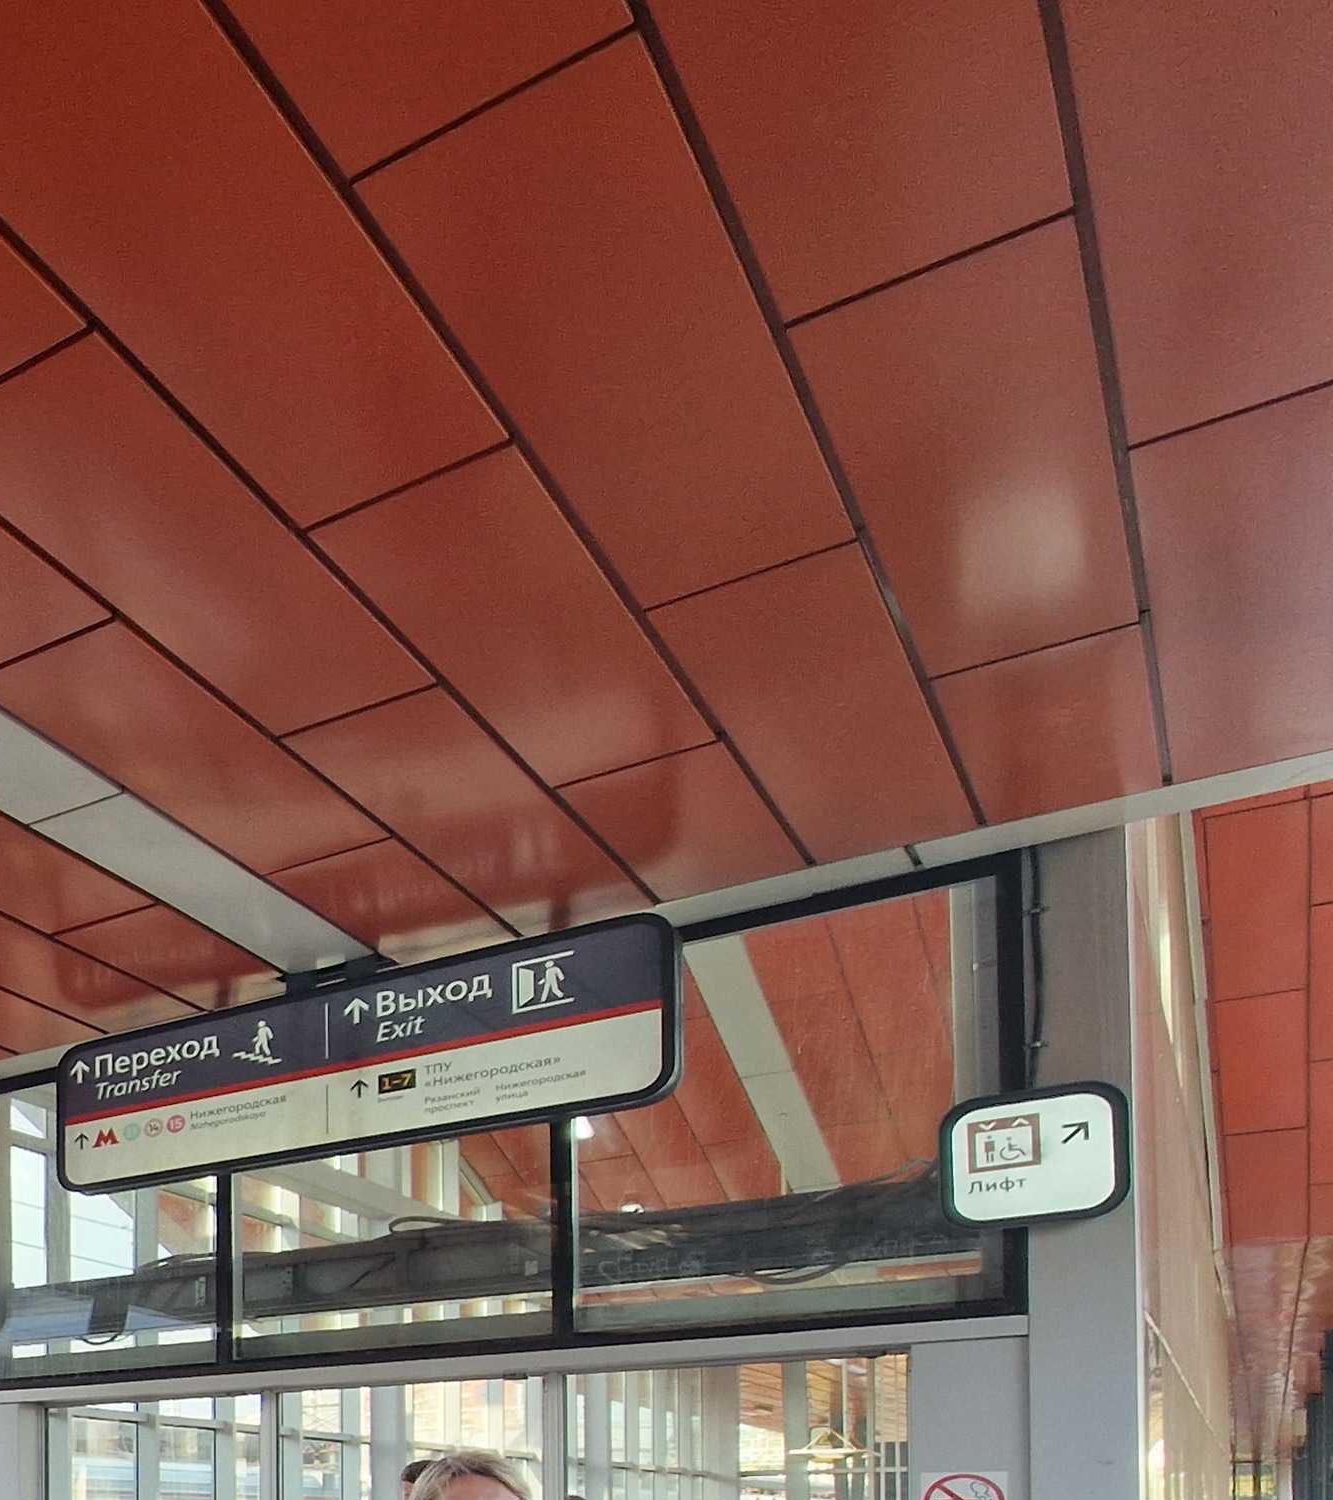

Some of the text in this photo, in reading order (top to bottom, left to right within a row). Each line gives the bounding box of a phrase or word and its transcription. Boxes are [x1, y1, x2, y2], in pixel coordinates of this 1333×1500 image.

[375, 974, 493, 1018] Выход
[375, 1016, 425, 1043] Exit
[94, 1034, 221, 1079] Переход
[423, 1062, 453, 1075] ТПУ
[95, 1067, 182, 1100] Transfer
[424, 1056, 561, 1087] «Нижегородская»
[190, 1094, 287, 1120] Нижегородская
[968, 1176, 1027, 1194] Лифт
